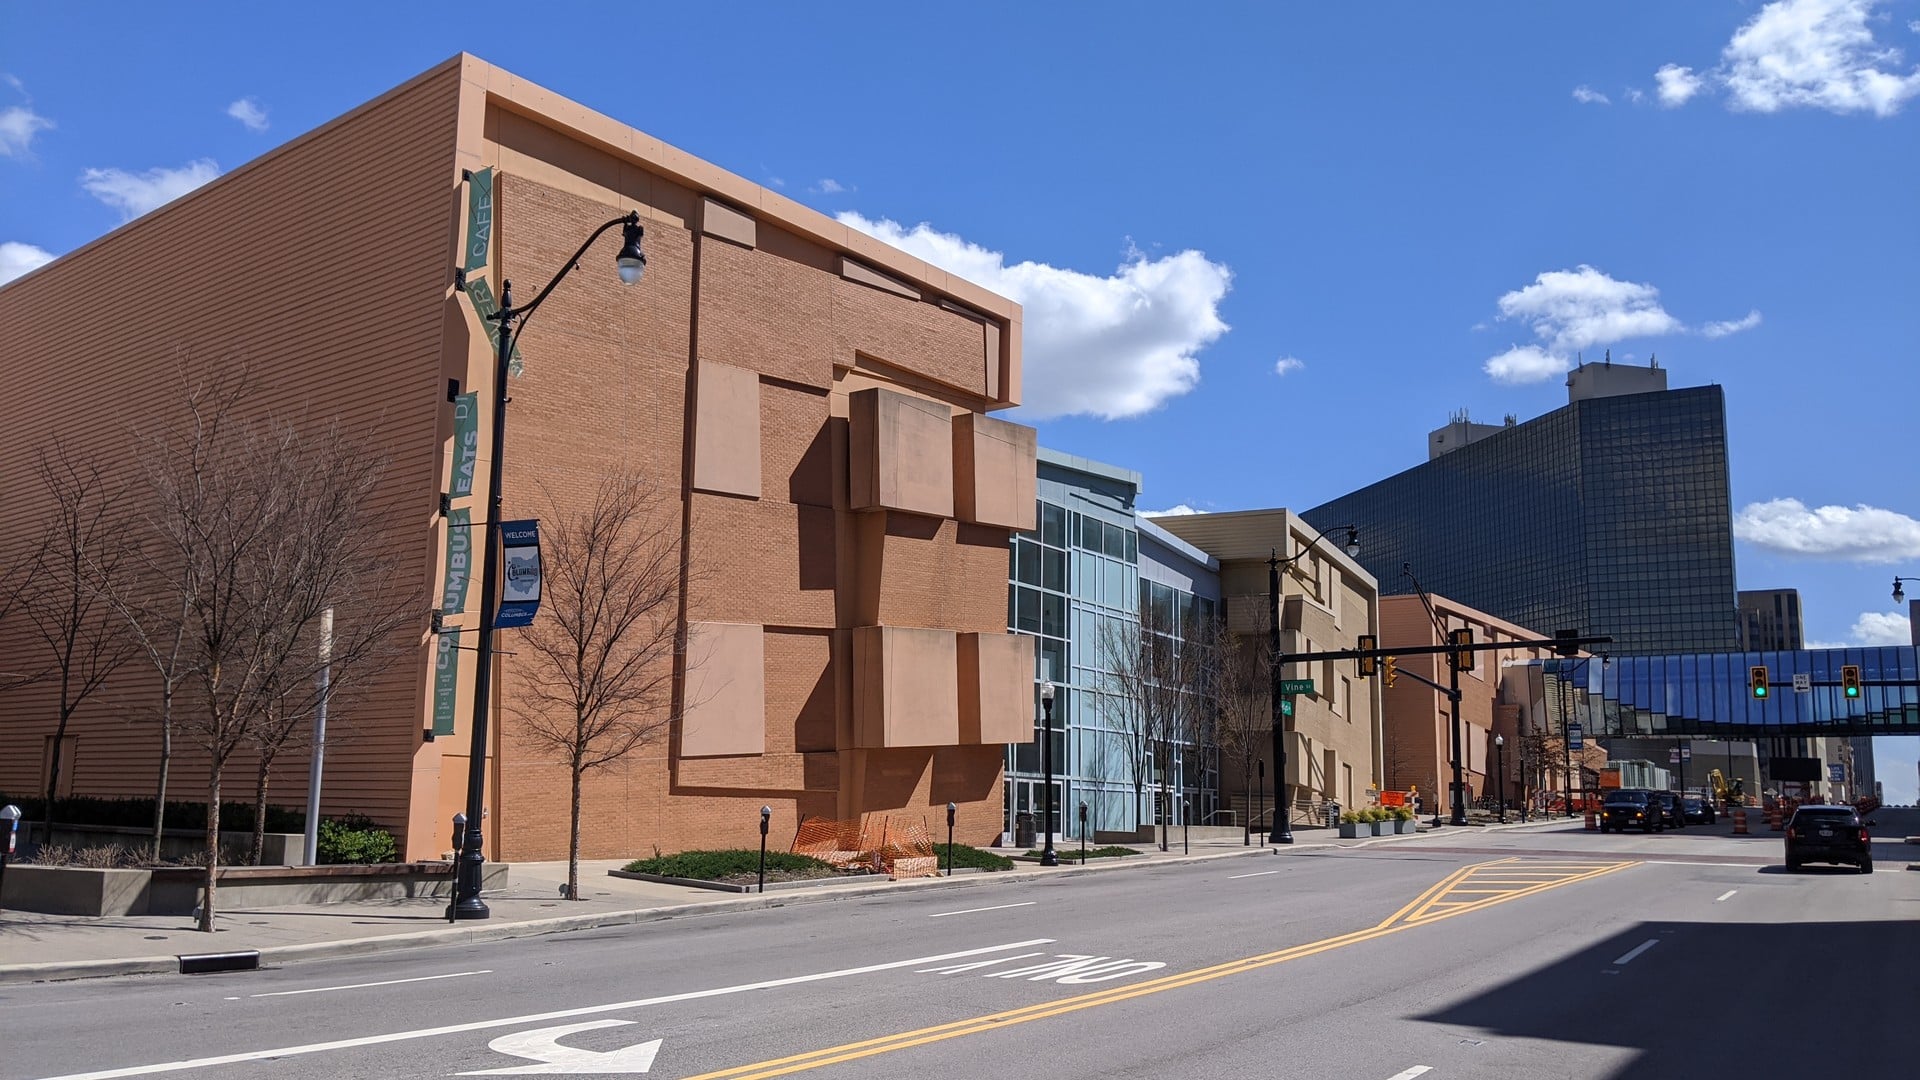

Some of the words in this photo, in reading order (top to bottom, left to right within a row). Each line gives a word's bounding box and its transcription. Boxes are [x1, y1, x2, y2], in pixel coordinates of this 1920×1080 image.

[473, 196, 492, 257] CAFE
[456, 431, 477, 493] EATS
[505, 530, 536, 539] WELCOME
[1285, 683, 1304, 691] Vine
[914, 952, 1167, 984] ONLY
